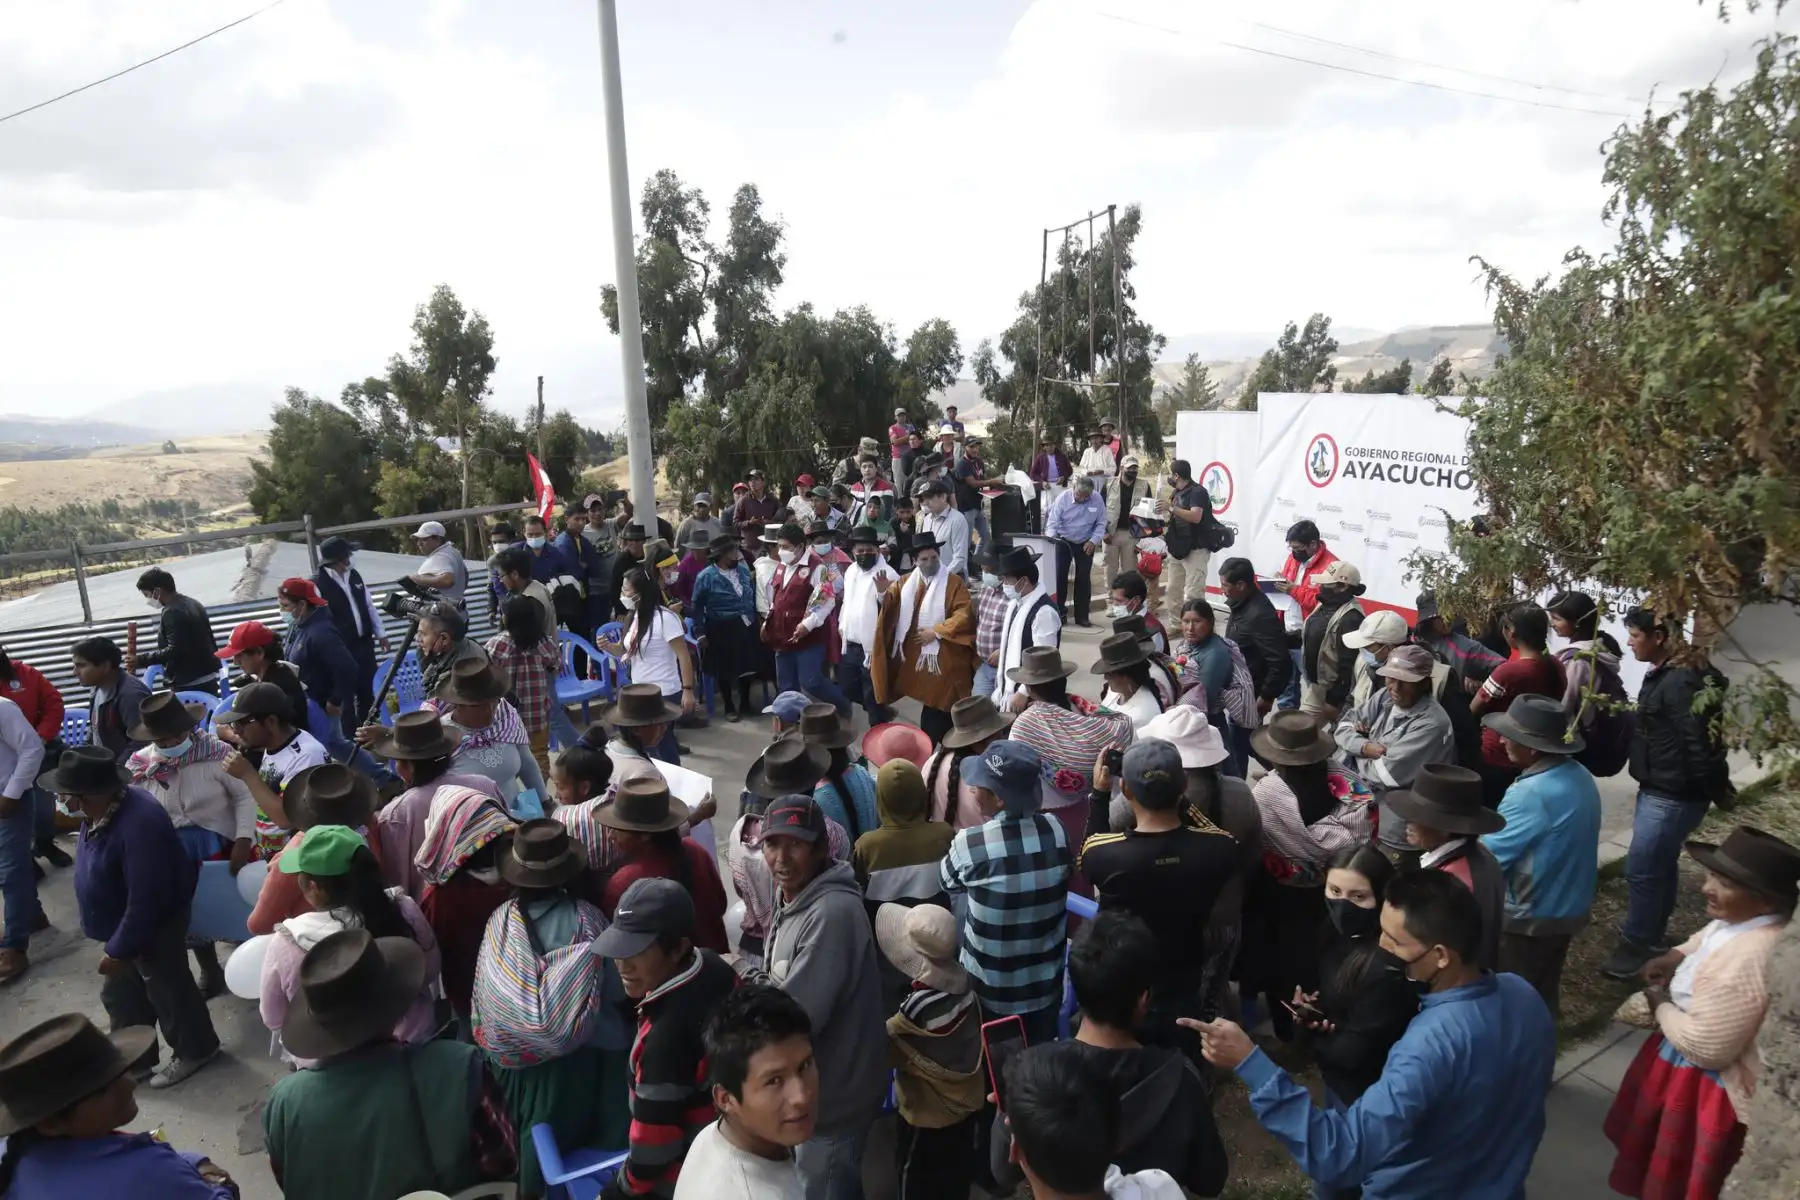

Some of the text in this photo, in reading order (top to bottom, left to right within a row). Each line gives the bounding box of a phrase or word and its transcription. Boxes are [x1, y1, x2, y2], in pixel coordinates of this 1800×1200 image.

[1344, 446, 1400, 461] GOBIERNO
[1401, 450, 1458, 466] REGIONAL
[1342, 459, 1474, 491] AYACUCHO
